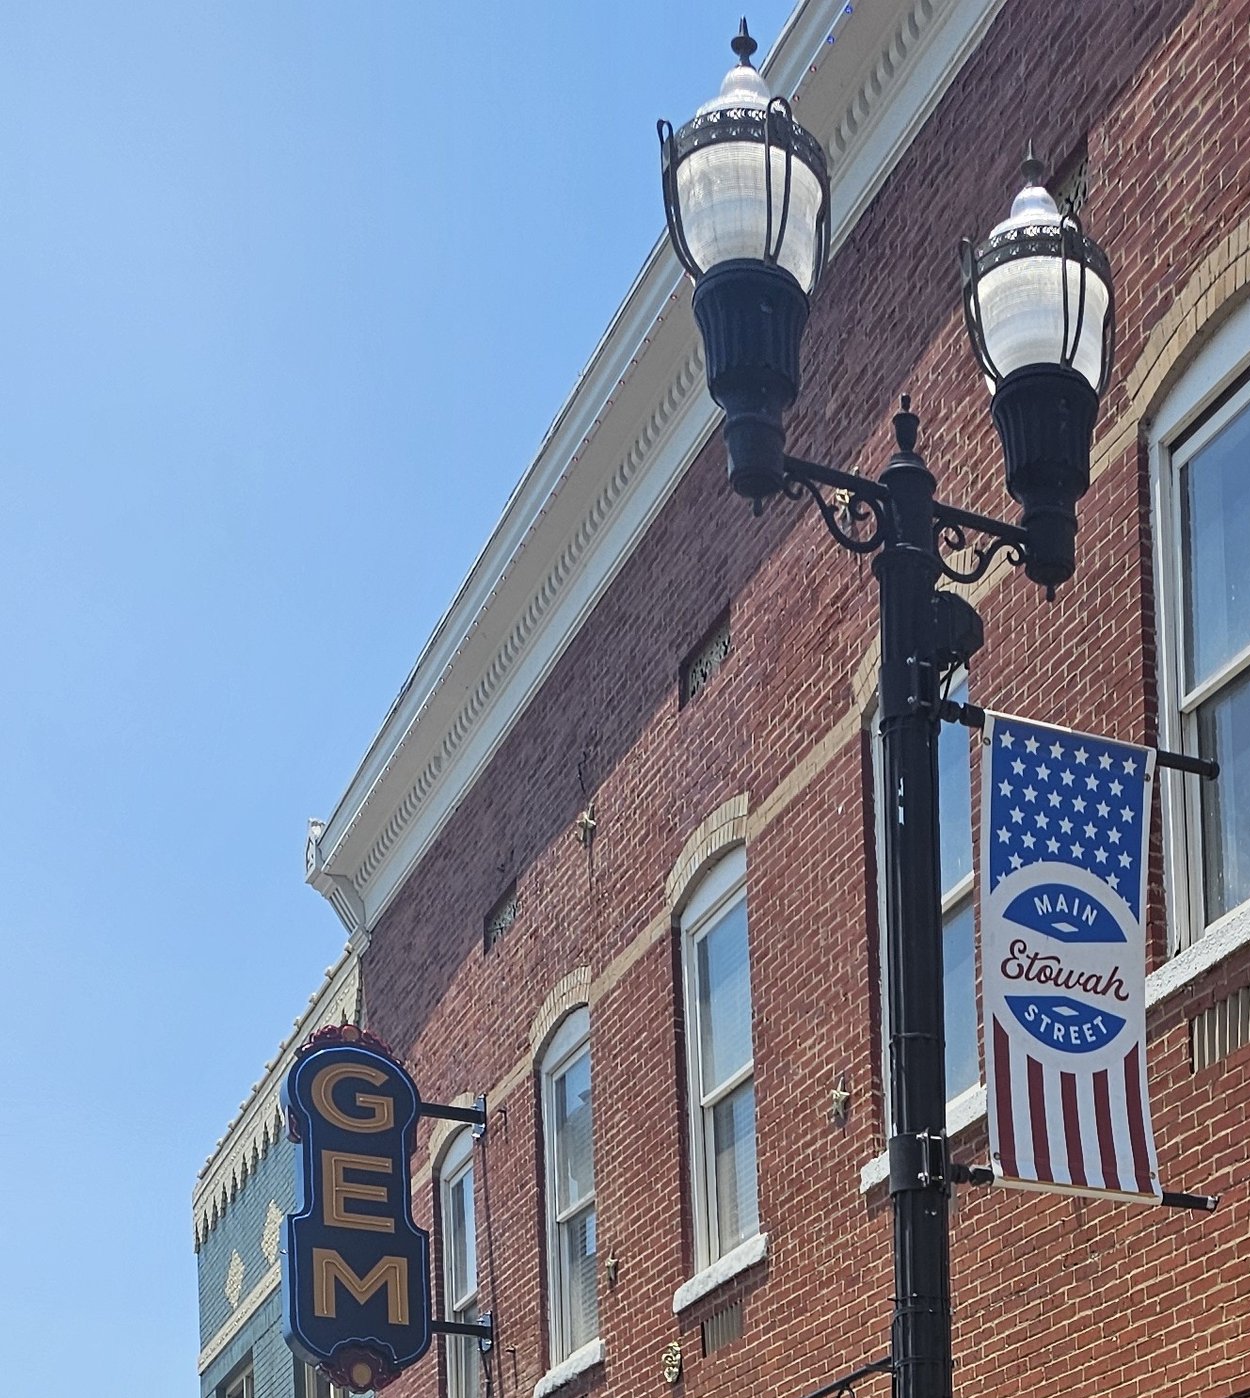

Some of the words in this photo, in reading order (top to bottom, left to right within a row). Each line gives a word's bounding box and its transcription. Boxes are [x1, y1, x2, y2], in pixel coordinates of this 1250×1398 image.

[1034, 893, 1097, 926] MAIN
[1000, 939, 1130, 1003] Etowah
[1024, 1004, 1107, 1044] STREET
[311, 1062, 410, 1326] GEM
